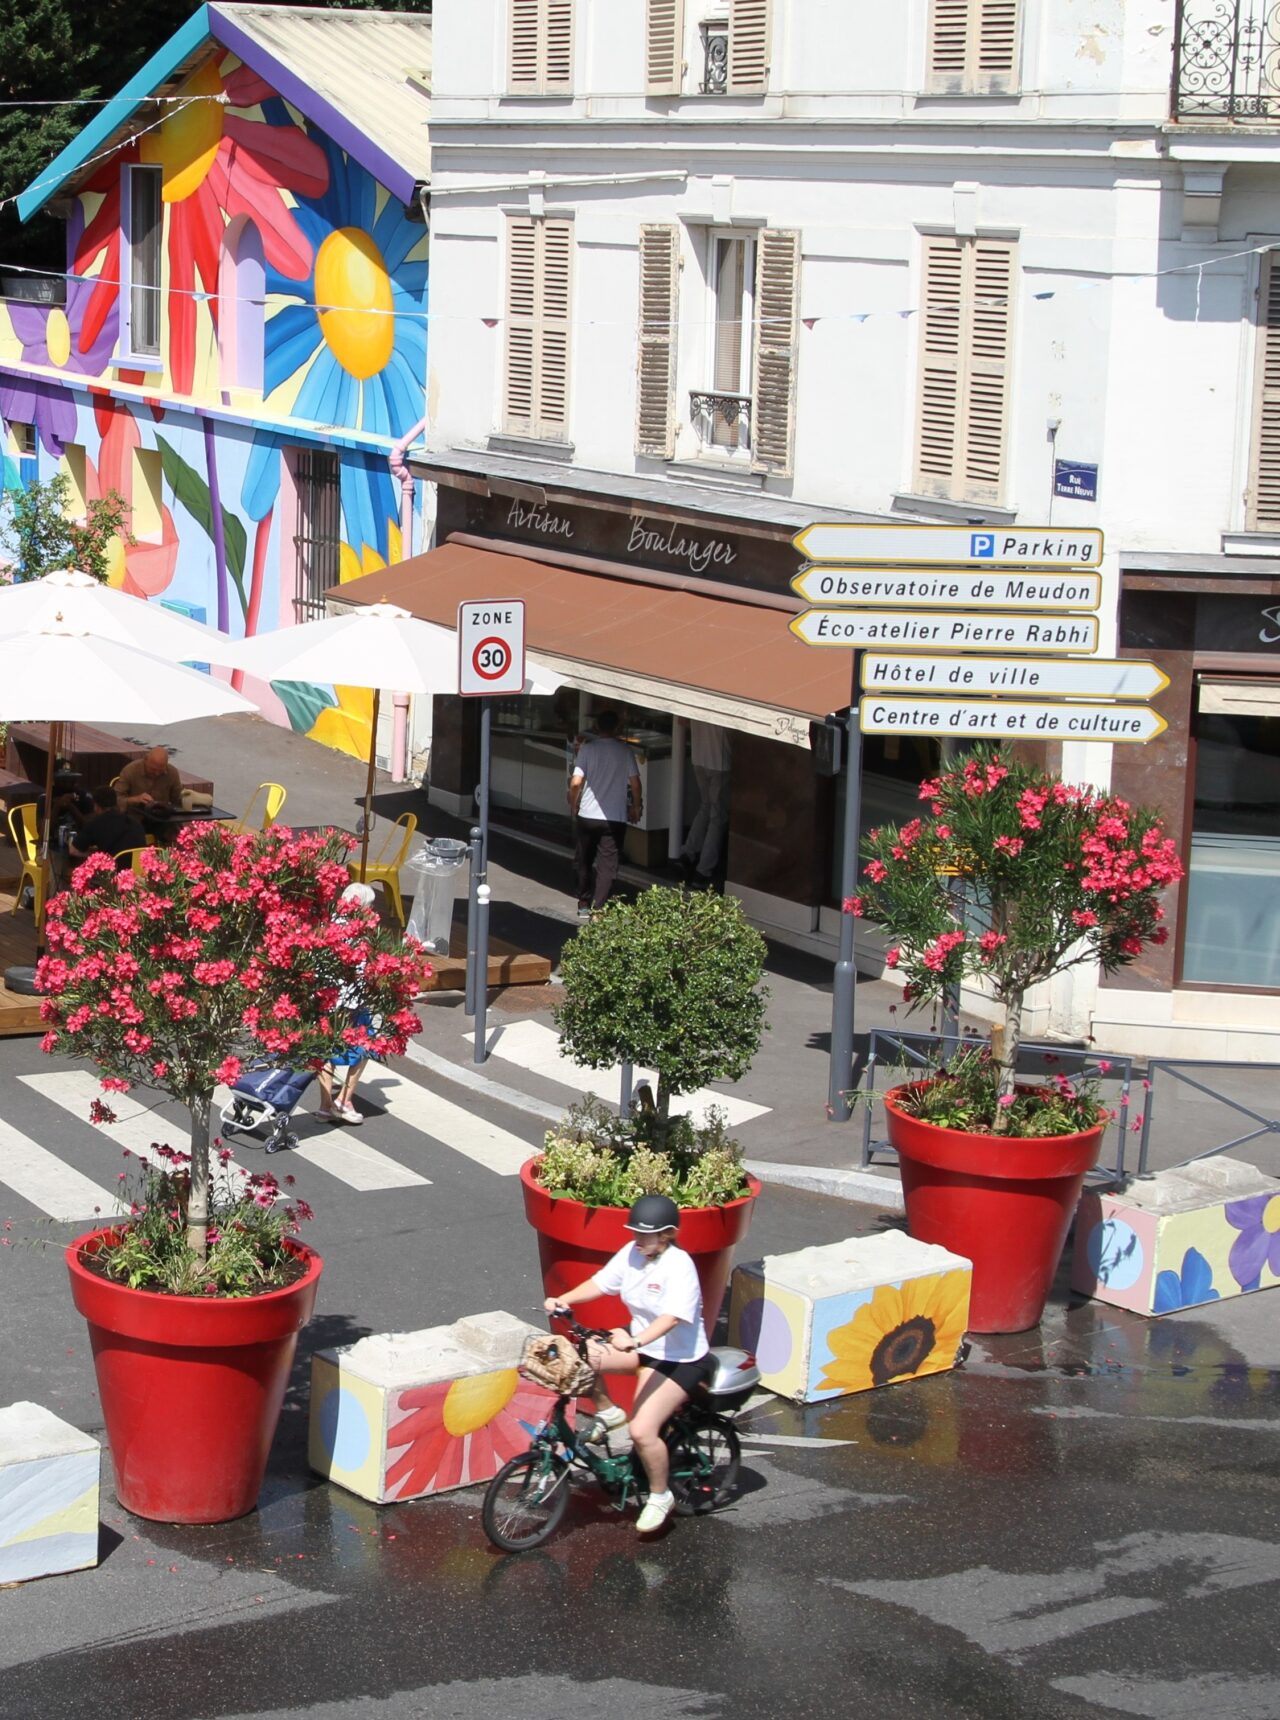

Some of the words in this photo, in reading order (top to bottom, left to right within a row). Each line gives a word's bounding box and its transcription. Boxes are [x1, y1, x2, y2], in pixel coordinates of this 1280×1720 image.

[1056, 482, 1074, 494] TERRE
[1074, 486, 1094, 497] NEUVE
[507, 497, 574, 538] Artisan
[627, 513, 737, 572] Boulanger
[1002, 537, 1093, 562] Parking
[820, 576, 959, 598] Observatoire
[970, 580, 995, 598] de
[1006, 581, 1091, 600] Meudon
[472, 611, 513, 625] ZONE
[817, 615, 940, 639] Éco-atelier
[950, 622, 1015, 642] Pierre
[1026, 624, 1090, 643] Rabhi
[480, 648, 504, 668] 30
[873, 663, 936, 682] Hôtel
[948, 666, 974, 683] de
[989, 667, 1040, 686] ville
[872, 706, 940, 726] Centre
[949, 709, 998, 728] d'art
[1006, 713, 1027, 729] et
[1036, 712, 1059, 730] de
[1068, 714, 1142, 732] culture
